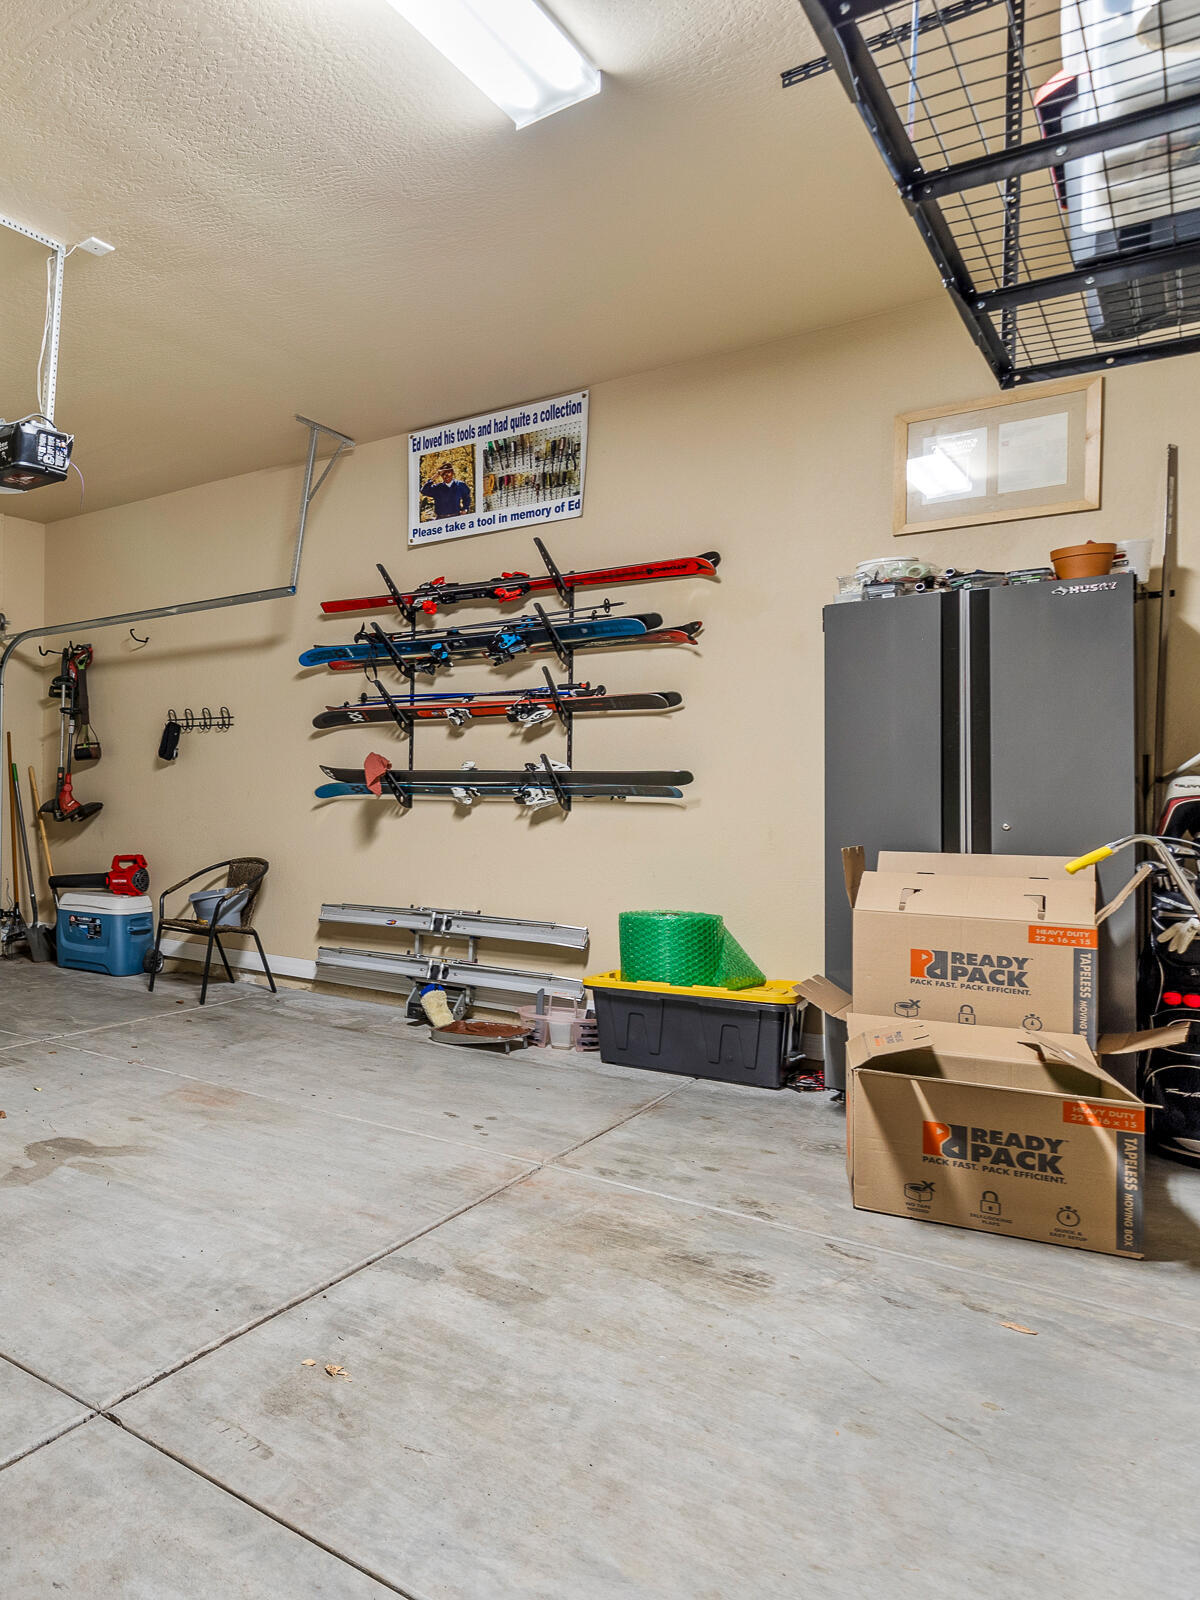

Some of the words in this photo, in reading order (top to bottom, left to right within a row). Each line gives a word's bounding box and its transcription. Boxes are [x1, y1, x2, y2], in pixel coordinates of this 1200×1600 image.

[412, 437, 421, 452] Ed
[423, 432, 442, 450] loved
[444, 429, 455, 445] his
[457, 425, 475, 442] tools
[477, 420, 492, 437] and
[493, 416, 508, 434] had
[510, 412, 531, 433] quite
[533, 412, 538, 424] a
[540, 400, 582, 422] collection
[412, 525, 442, 538] Please
[445, 520, 466, 533] take
[468, 520, 474, 528] a
[477, 515, 496, 527] tool
[498, 513, 507, 523] in
[510, 506, 551, 522] memory
[554, 502, 565, 514] of
[568, 498, 581, 510] Ed
[1068, 581, 1118, 594] HUSKY
[1036, 928, 1065, 937] HEAVY
[1066, 930, 1091, 938] DUTY
[951, 952, 1030, 971] READY
[910, 978, 932, 986] PACK
[935, 980, 957, 989] FAST.
[960, 983, 983, 991] PACK
[986, 986, 1032, 996] EFFICIENT.
[951, 965, 1029, 988] PACK
[1080, 953, 1091, 998] TAPELESS
[1080, 1000, 1088, 1029] MOVING
[1071, 1113, 1084, 1122] 22
[1124, 1120, 1137, 1129] 15
[1072, 1105, 1106, 1117] HEAVY
[1109, 1109, 1136, 1120] DUTY
[971, 1127, 1065, 1154] READY
[922, 1155, 949, 1166] PACK
[952, 1160, 978, 1171] FAST.
[982, 1165, 1010, 1176] PACK
[1013, 1170, 1067, 1185] EFFICIENT.
[971, 1143, 1064, 1175] PACK
[1124, 1138, 1138, 1191] TAPELESS
[1123, 1193, 1134, 1227] MOVING
[1068, 1234, 1088, 1242] SETUP
[1123, 1229, 1134, 1247] BOX
